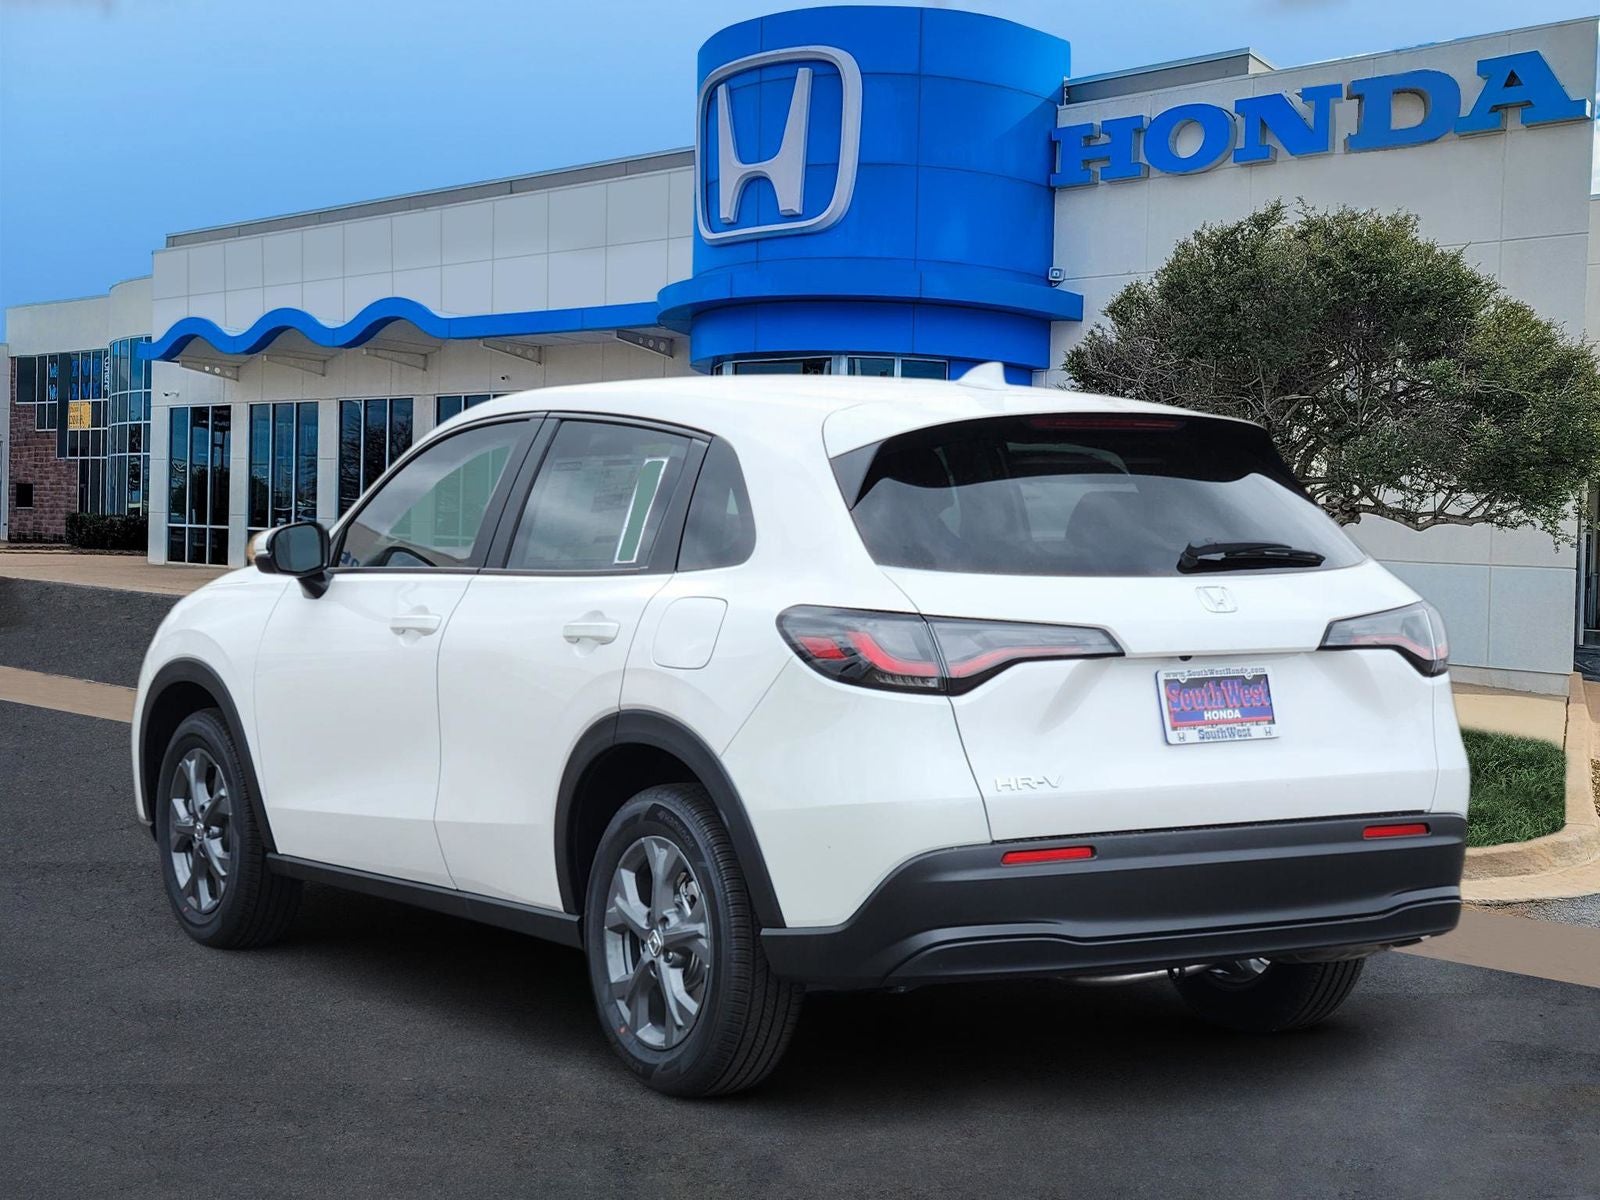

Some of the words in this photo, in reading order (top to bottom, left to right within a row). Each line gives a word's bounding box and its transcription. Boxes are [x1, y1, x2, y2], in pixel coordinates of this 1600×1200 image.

[1051, 50, 1591, 188] HONDA
[1166, 679, 1271, 711] SouthWest
[1204, 709, 1242, 720] HONDA
[1198, 727, 1252, 740] SouthWest
[995, 775, 1063, 792] HR-V
